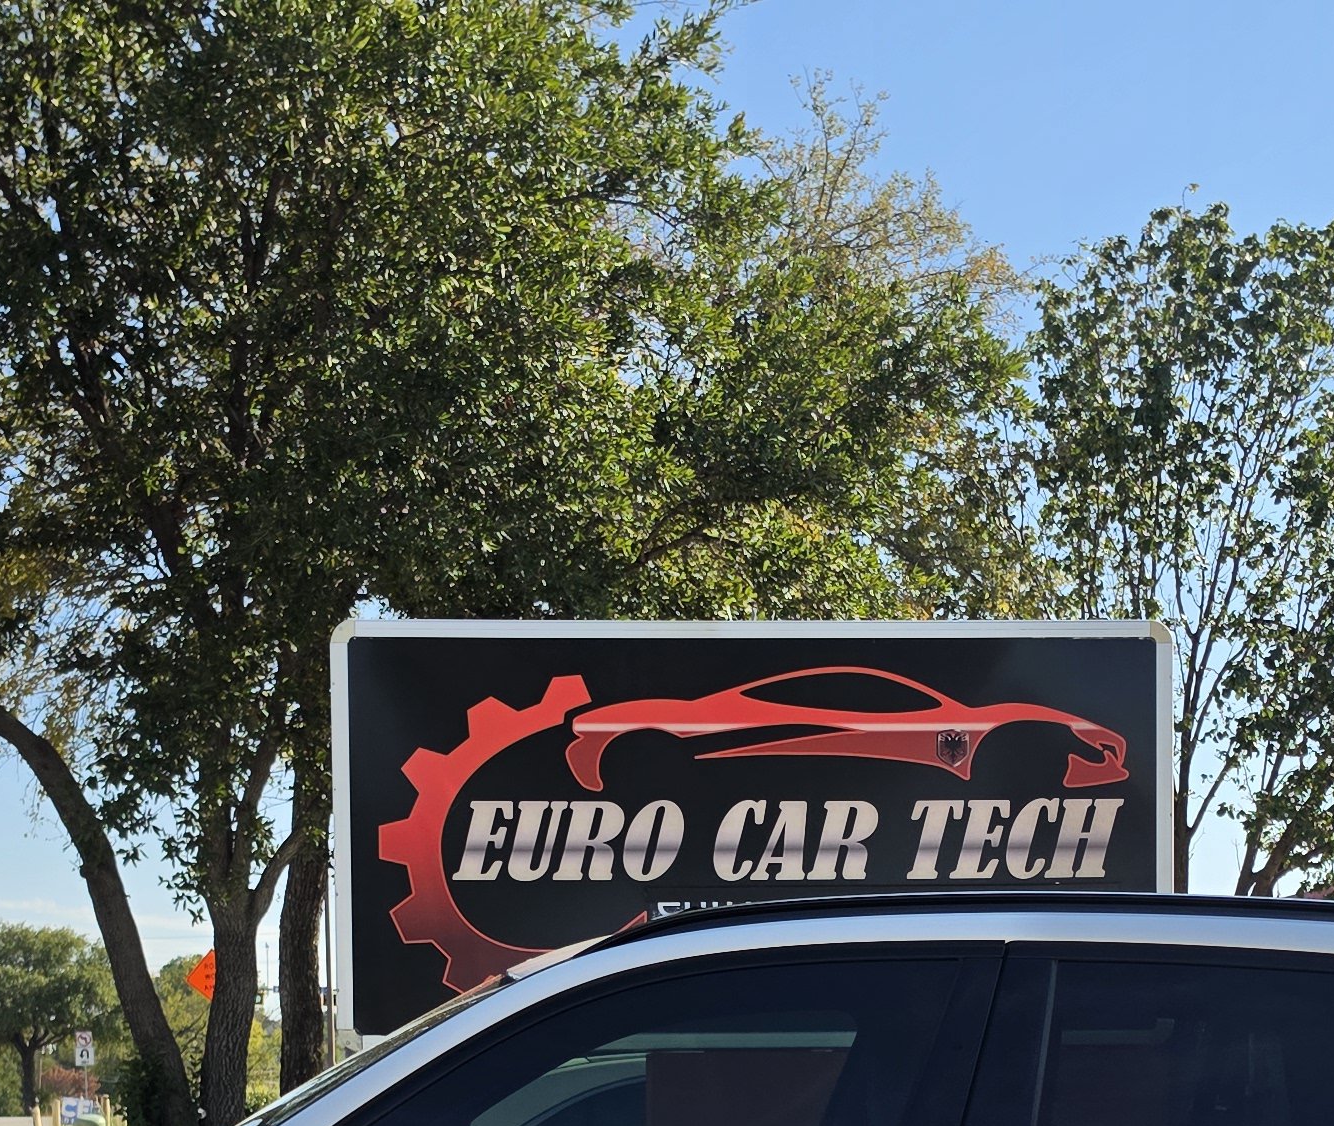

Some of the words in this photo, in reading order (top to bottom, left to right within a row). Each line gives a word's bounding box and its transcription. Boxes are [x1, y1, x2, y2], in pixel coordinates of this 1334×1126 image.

[452, 799, 685, 882] EURO
[713, 799, 879, 882] CAR
[906, 797, 1125, 880] TECH
